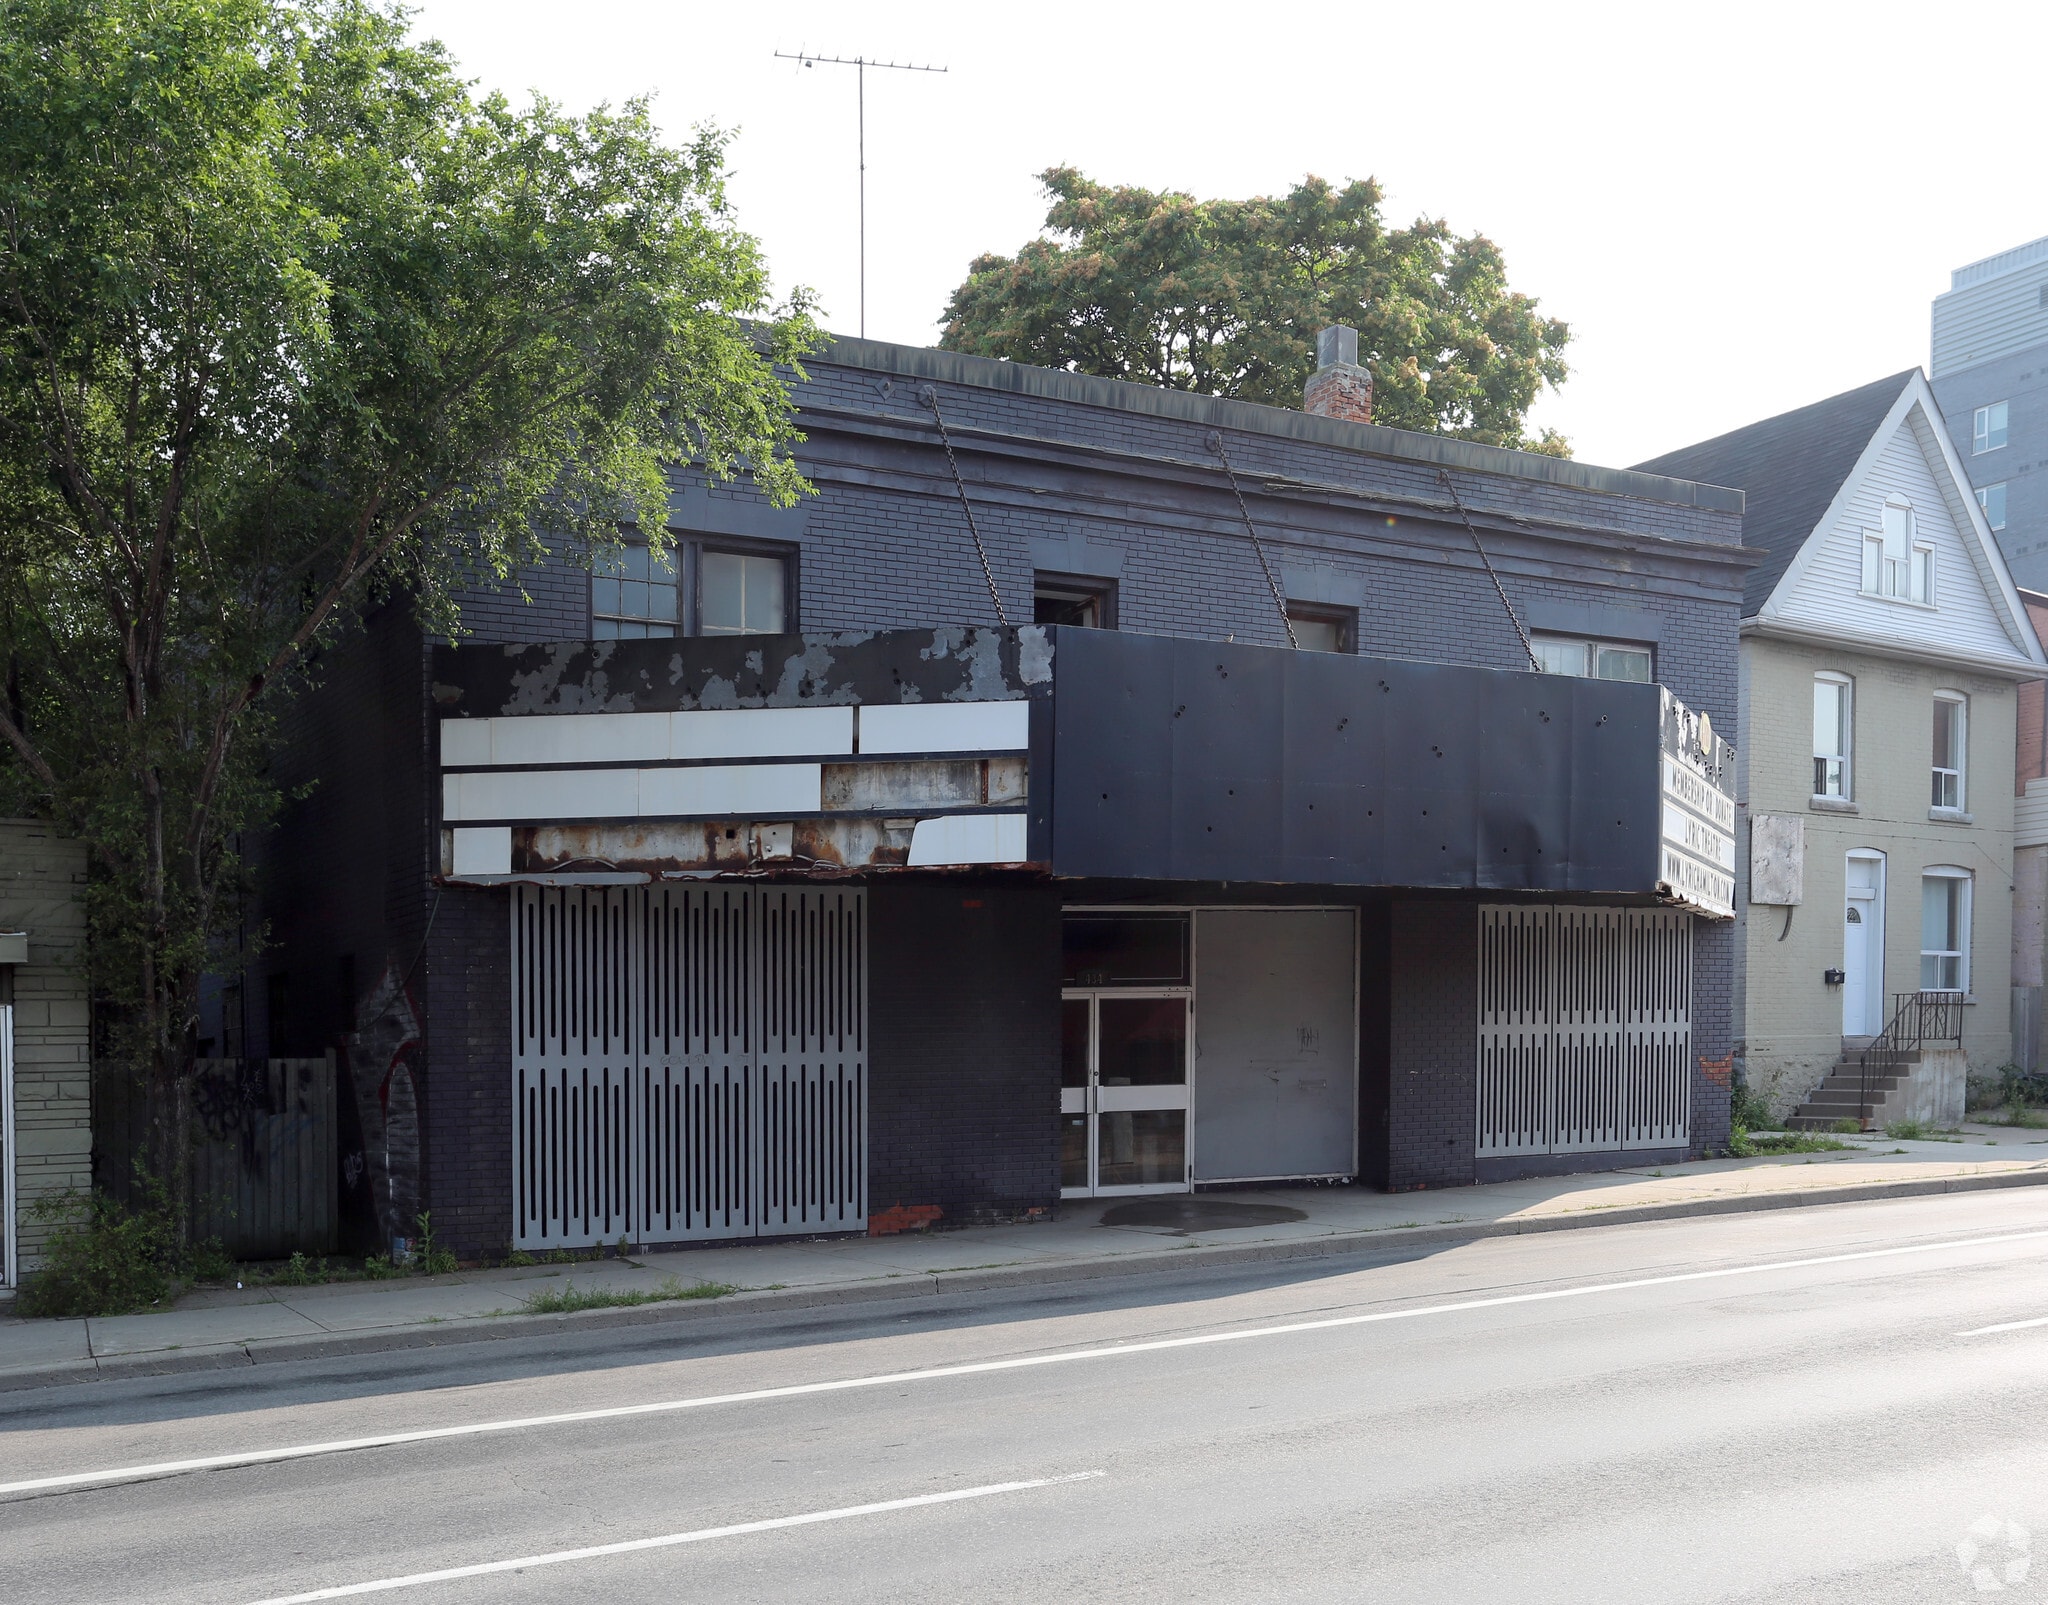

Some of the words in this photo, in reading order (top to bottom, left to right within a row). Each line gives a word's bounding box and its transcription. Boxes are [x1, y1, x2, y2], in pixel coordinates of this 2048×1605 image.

[1672, 765, 1704, 807] MEMBERSHIP
[1706, 789, 1713, 815] OR
[1715, 797, 1732, 828] DONATE
[1685, 817, 1700, 849] LYRIC
[1701, 827, 1721, 861] THEATRE
[1667, 853, 1730, 904] WWW.LYRICHAMILTON.COM
